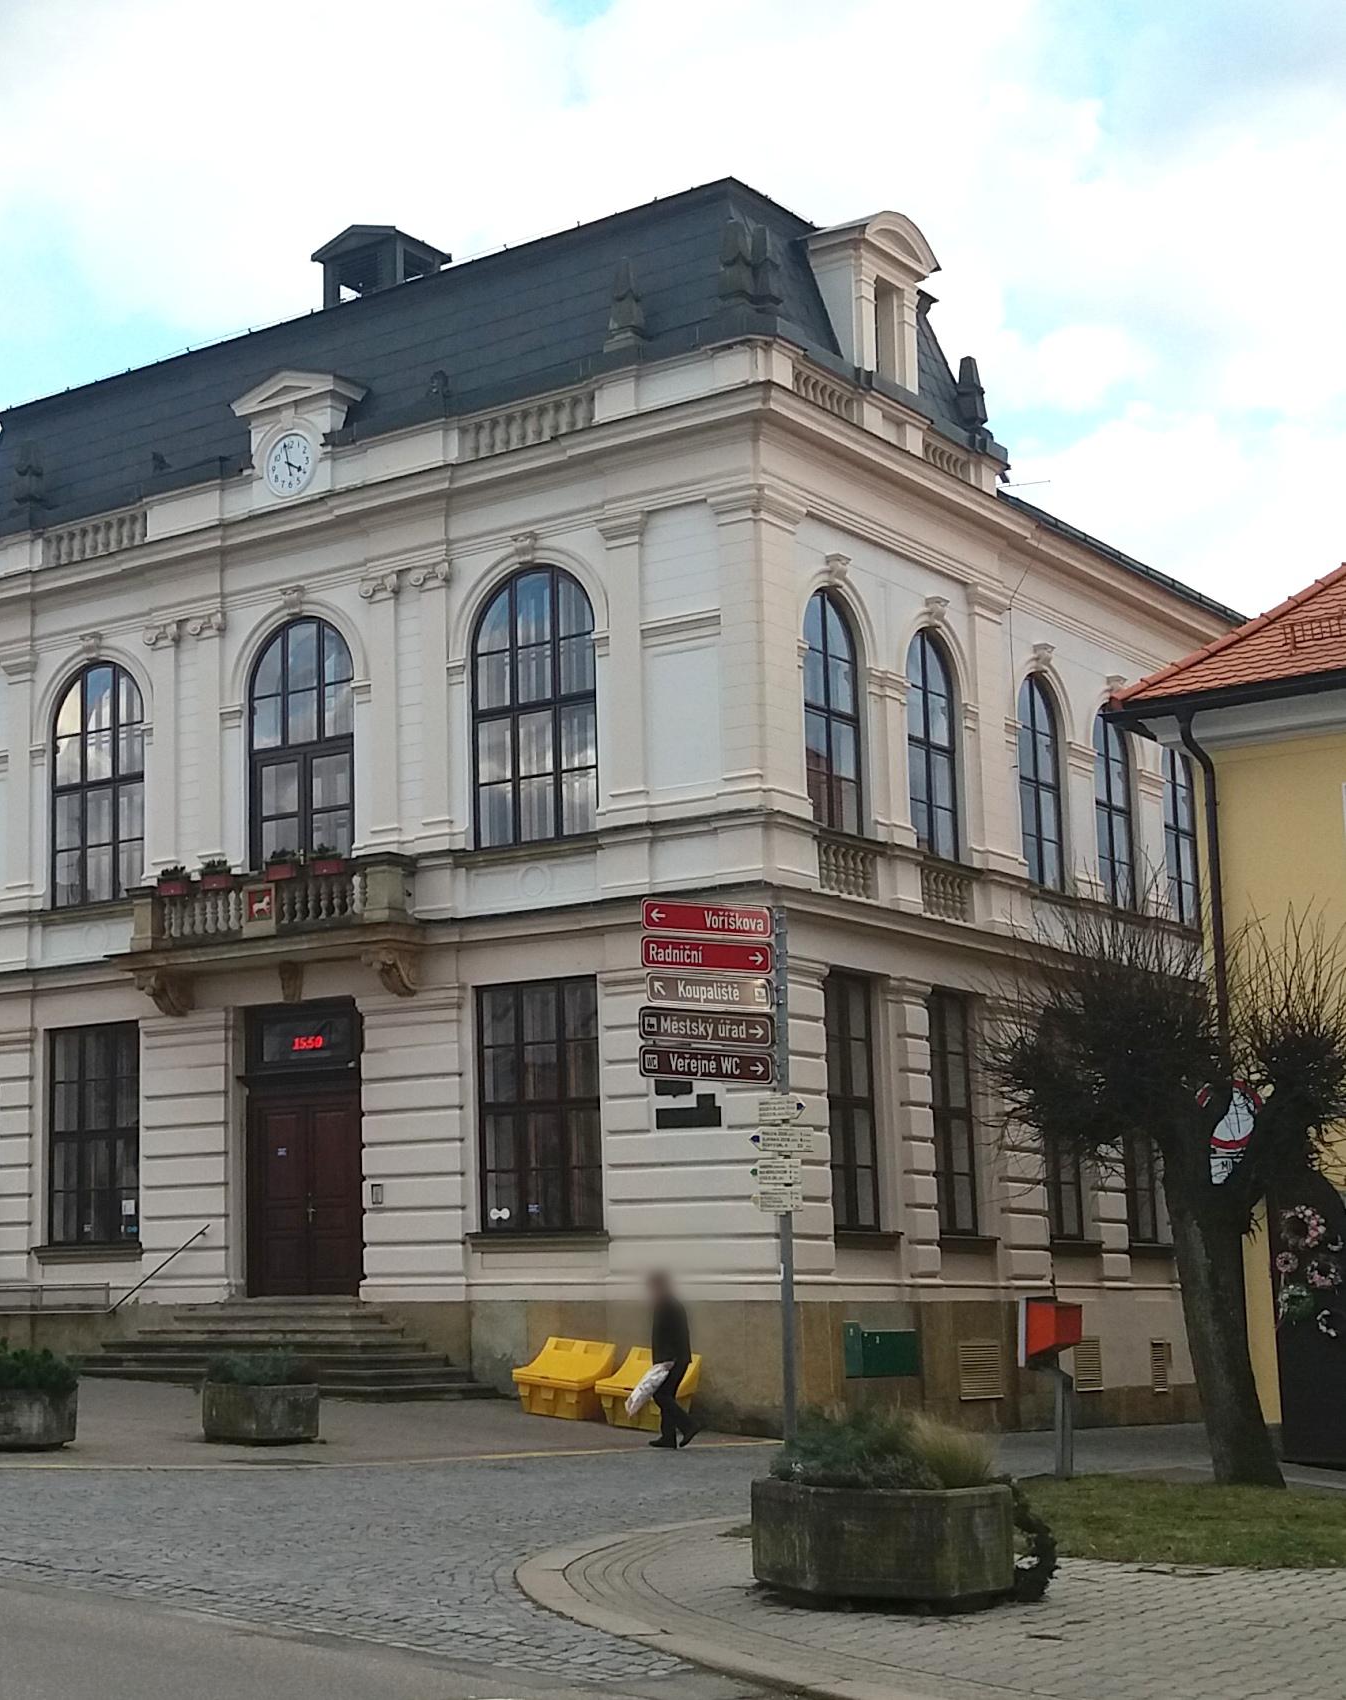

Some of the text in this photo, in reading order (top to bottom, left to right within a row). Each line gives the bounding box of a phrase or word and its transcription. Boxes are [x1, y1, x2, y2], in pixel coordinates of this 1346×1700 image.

[704, 910, 764, 932] Voříškova
[649, 943, 703, 964] Radniční
[677, 980, 740, 1003] Koupaliště
[660, 1015, 747, 1040] Městský úřad
[669, 1053, 741, 1077] Veřejné WC
